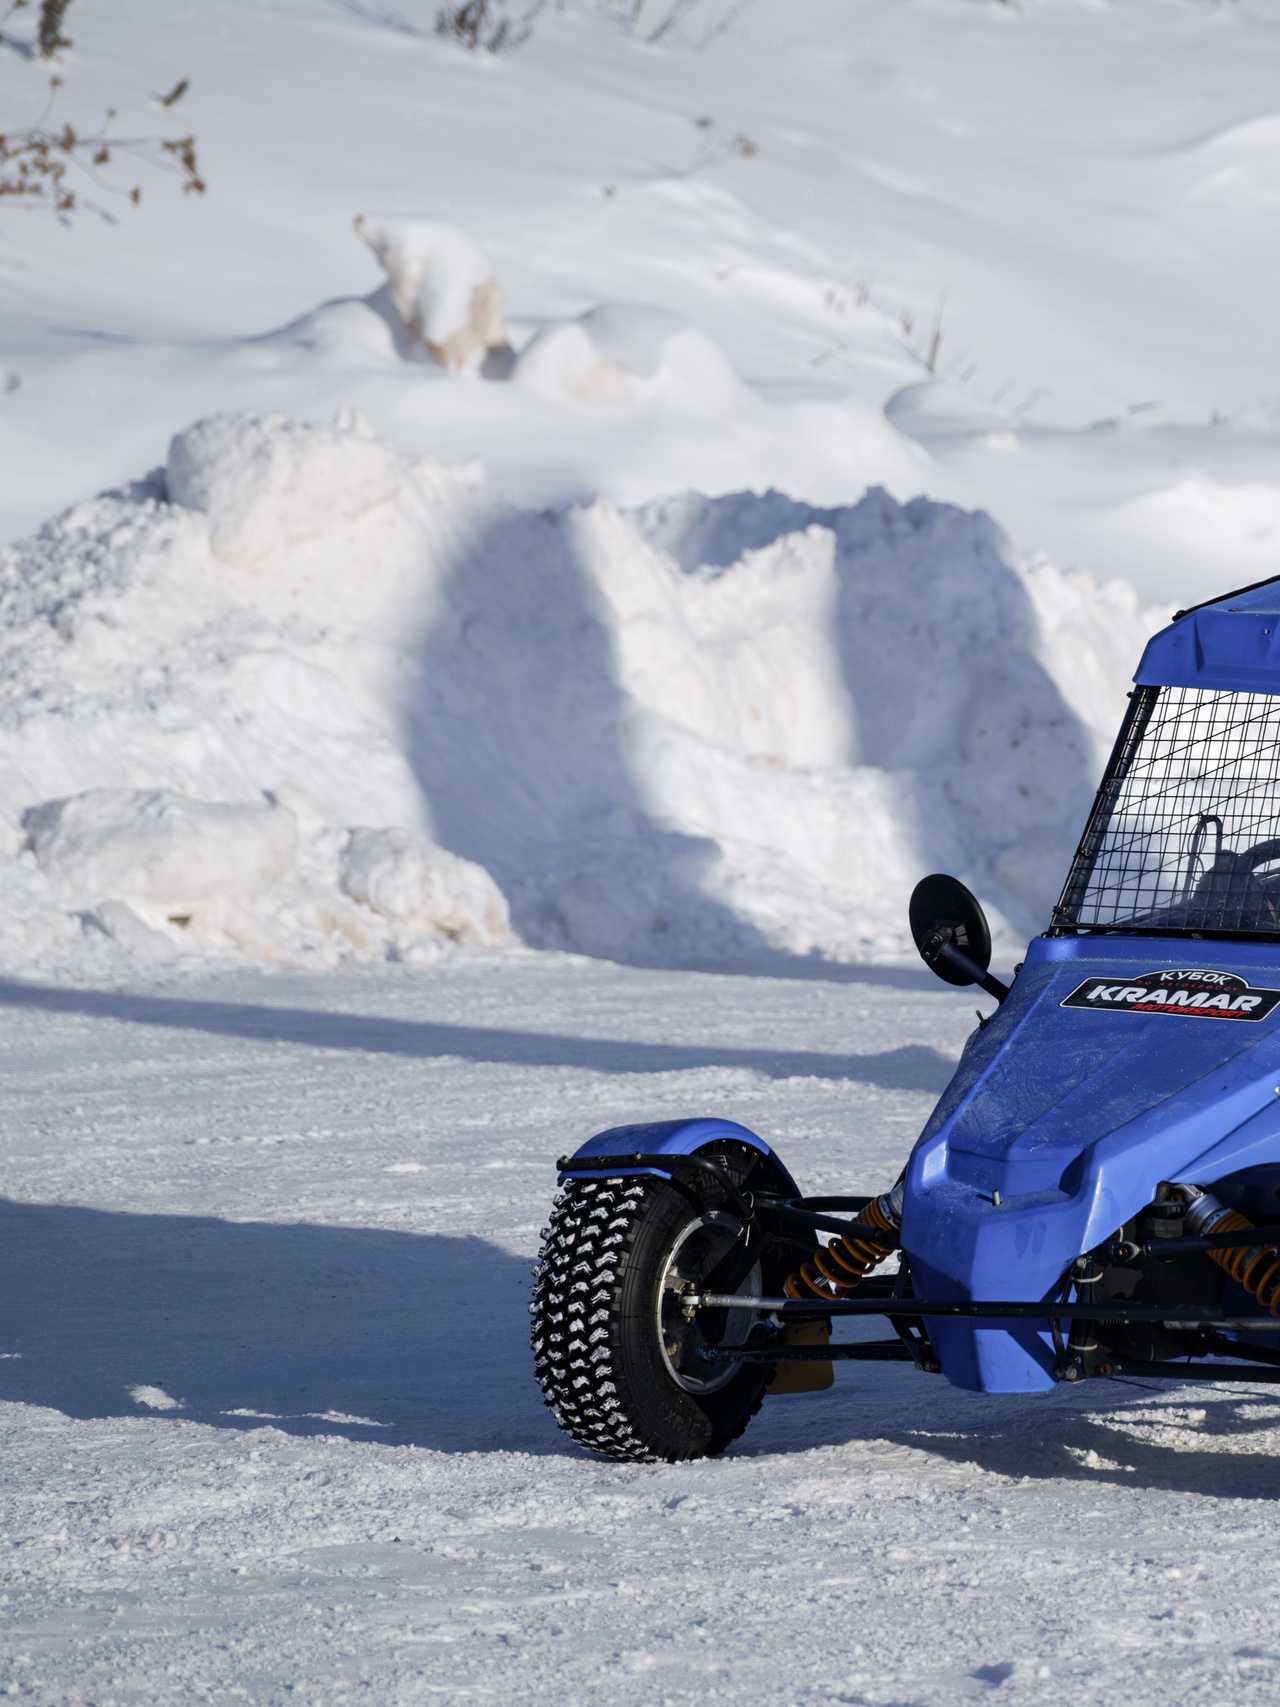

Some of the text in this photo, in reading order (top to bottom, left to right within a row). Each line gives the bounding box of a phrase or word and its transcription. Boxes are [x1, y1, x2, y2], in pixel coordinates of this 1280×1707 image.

[1160, 972, 1232, 986] КУБОК
[1086, 985, 1262, 1012] KRAMAR
[1130, 1003, 1251, 1018] MOTORSPORT
